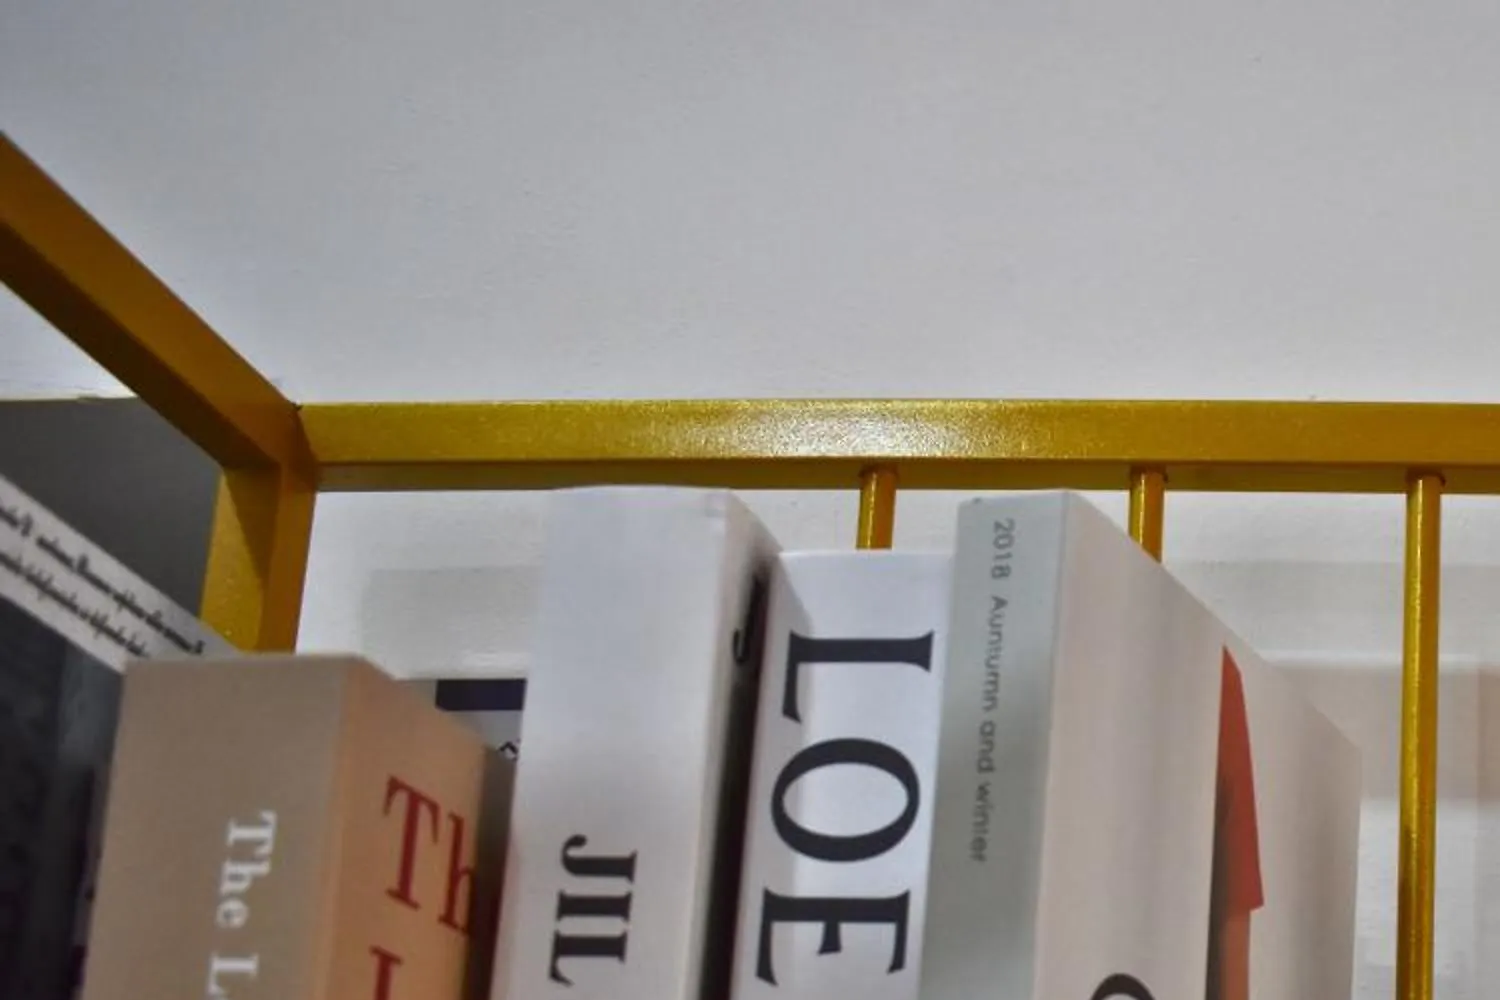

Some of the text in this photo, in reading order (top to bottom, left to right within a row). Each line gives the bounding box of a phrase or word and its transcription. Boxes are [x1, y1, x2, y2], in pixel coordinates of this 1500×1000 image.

[990, 517, 1016, 580] 2018
[976, 721, 997, 776] and
[969, 780, 993, 864] winter
[216, 809, 277, 929] The
